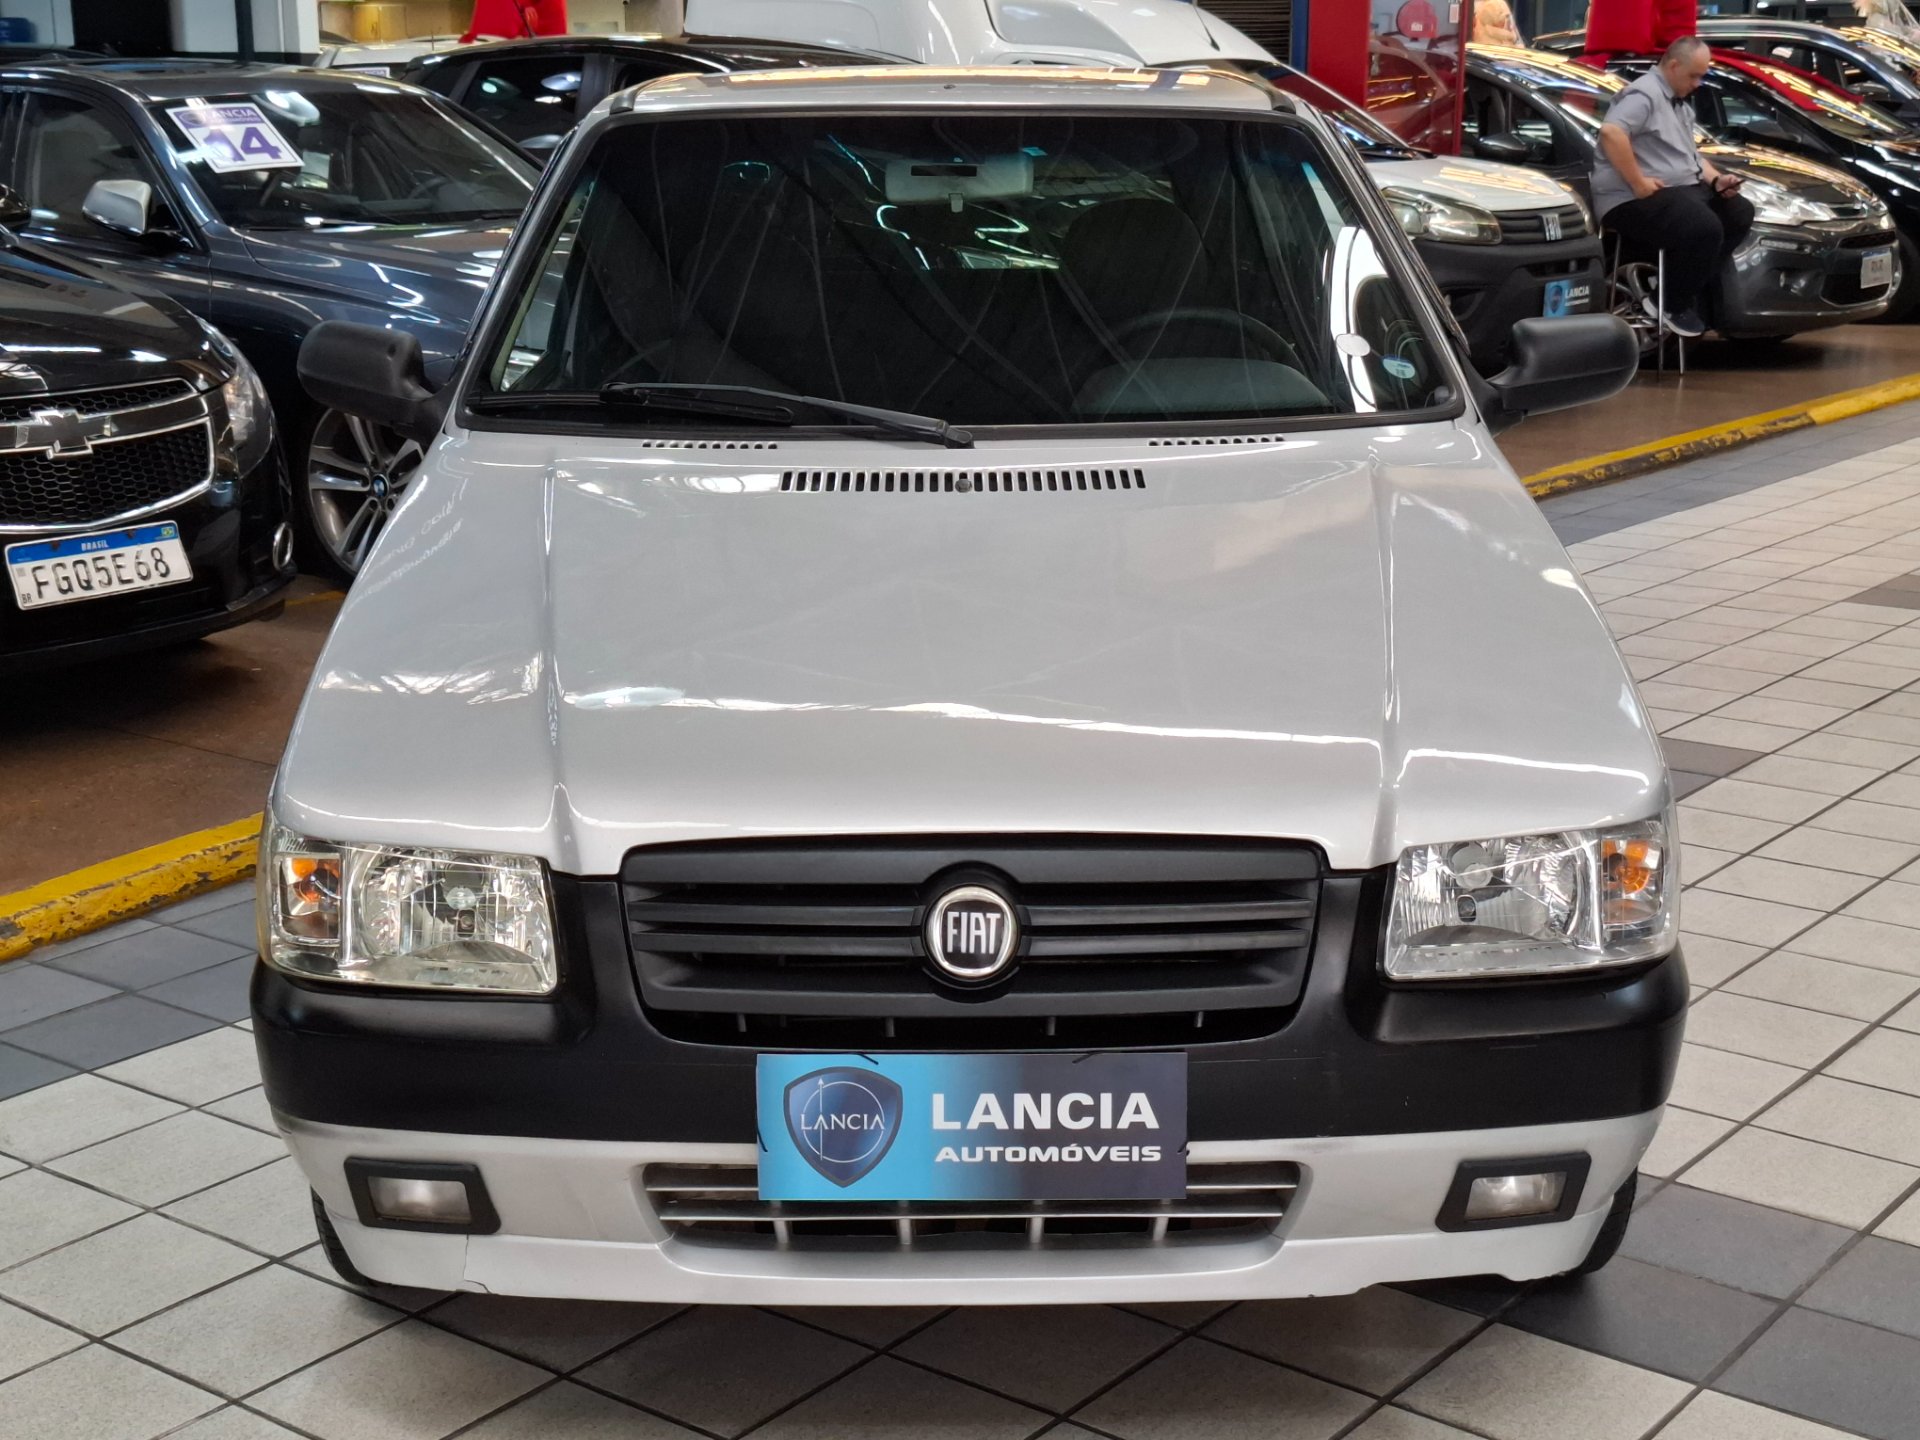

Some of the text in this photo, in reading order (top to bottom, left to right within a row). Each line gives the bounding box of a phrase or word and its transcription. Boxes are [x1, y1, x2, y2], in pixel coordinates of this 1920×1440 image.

[203, 126, 282, 162] 14
[1565, 286, 1590, 299] LANCIA
[81, 540, 109, 551] BRASIL
[31, 547, 170, 599] FGQ5E68
[947, 911, 1001, 954] FIAT
[800, 1113, 885, 1130] LANCIA
[932, 1092, 1160, 1130] LANCIA
[935, 1143, 1162, 1162] AUTOMÓVEIS
